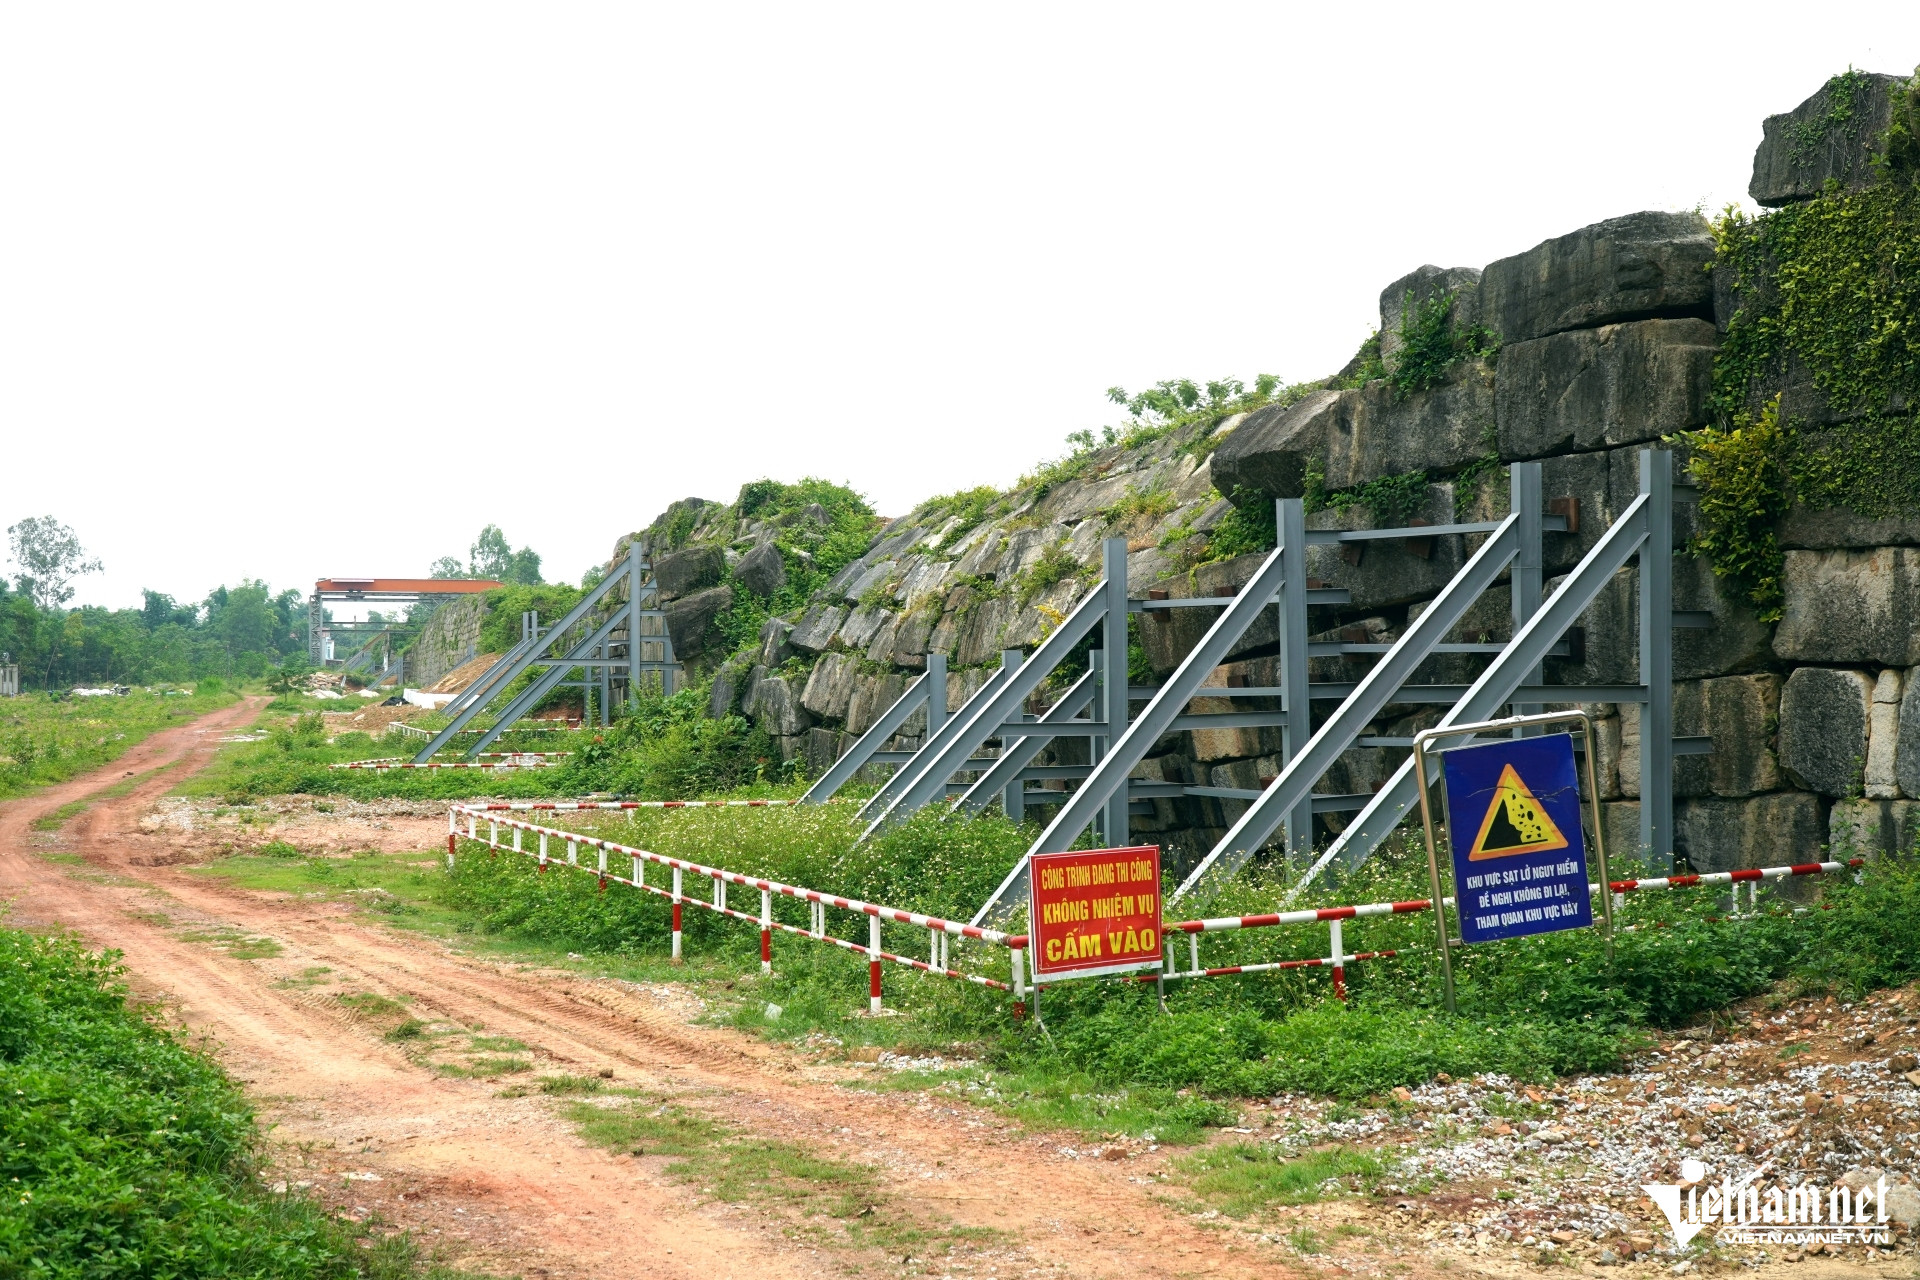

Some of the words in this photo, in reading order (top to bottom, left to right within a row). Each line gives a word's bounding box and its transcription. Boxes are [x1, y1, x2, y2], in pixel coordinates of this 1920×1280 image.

[1042, 864, 1064, 890] CÔNG
[1066, 862, 1091, 887] TRÌNH
[1092, 863, 1114, 885] ĐANG
[1116, 862, 1128, 882] THI
[1131, 857, 1152, 881] CÔNG
[1467, 876, 1482, 889] KHU
[1485, 872, 1501, 887] VỰC
[1503, 870, 1518, 885] SẠT
[1520, 864, 1530, 881] LỞ
[1533, 865, 1554, 879] NGUY
[1557, 858, 1578, 875] HIỂM
[1044, 898, 1088, 924] KHÔNG
[1093, 893, 1134, 921] NHIỆM
[1138, 894, 1154, 918] VỤ
[1479, 891, 1490, 908] ĐỀ
[1492, 892, 1512, 906] NGHỊ
[1514, 886, 1542, 902] KHÔNG
[1544, 885, 1552, 896] ĐI
[1476, 915, 1499, 929] THAM
[1501, 912, 1524, 926] QUAN
[1525, 908, 1542, 922] KHU
[1544, 905, 1560, 921] VỰC
[1562, 901, 1578, 916] NÀY
[1047, 928, 1101, 961] CẤM
[1109, 926, 1155, 954] VÀO
